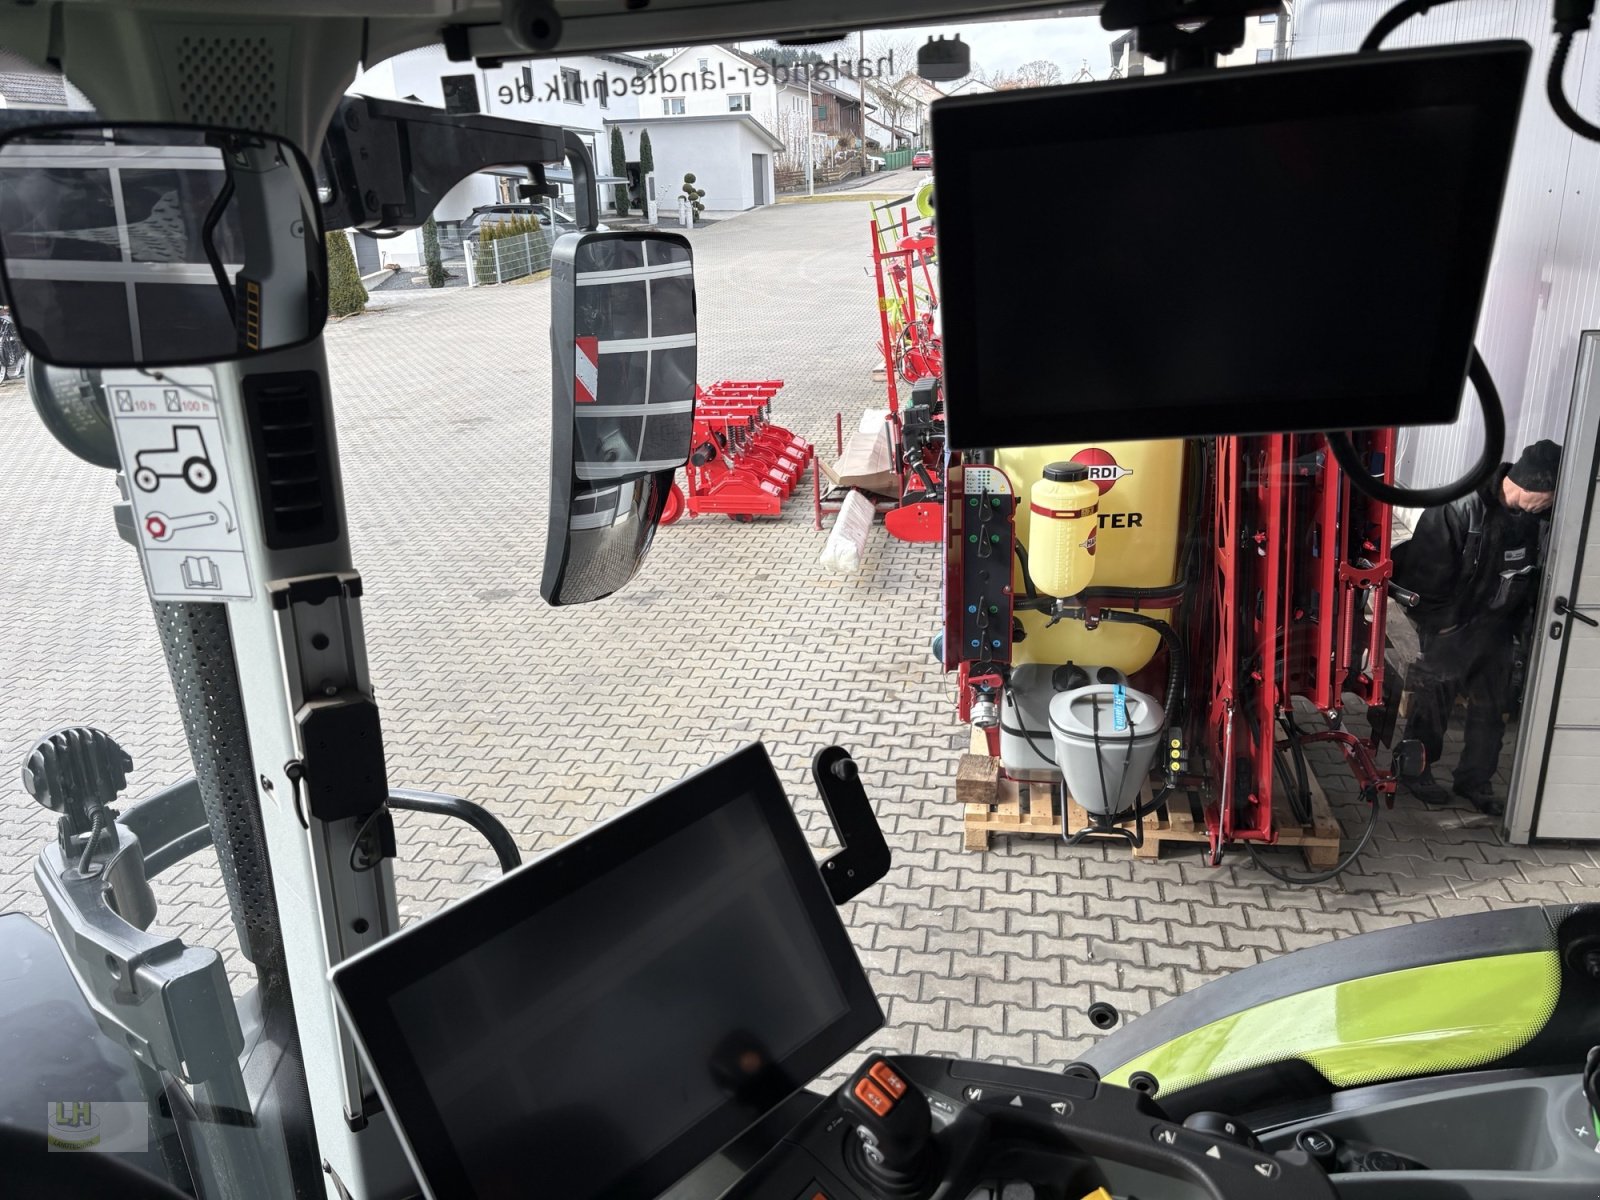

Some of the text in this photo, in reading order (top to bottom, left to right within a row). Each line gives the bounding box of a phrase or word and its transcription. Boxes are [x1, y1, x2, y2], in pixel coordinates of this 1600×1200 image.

[134, 400, 148, 411] 10
[182, 400, 201, 411] 100
[1089, 467, 1117, 479] RDI
[1097, 512, 1143, 529] TER
